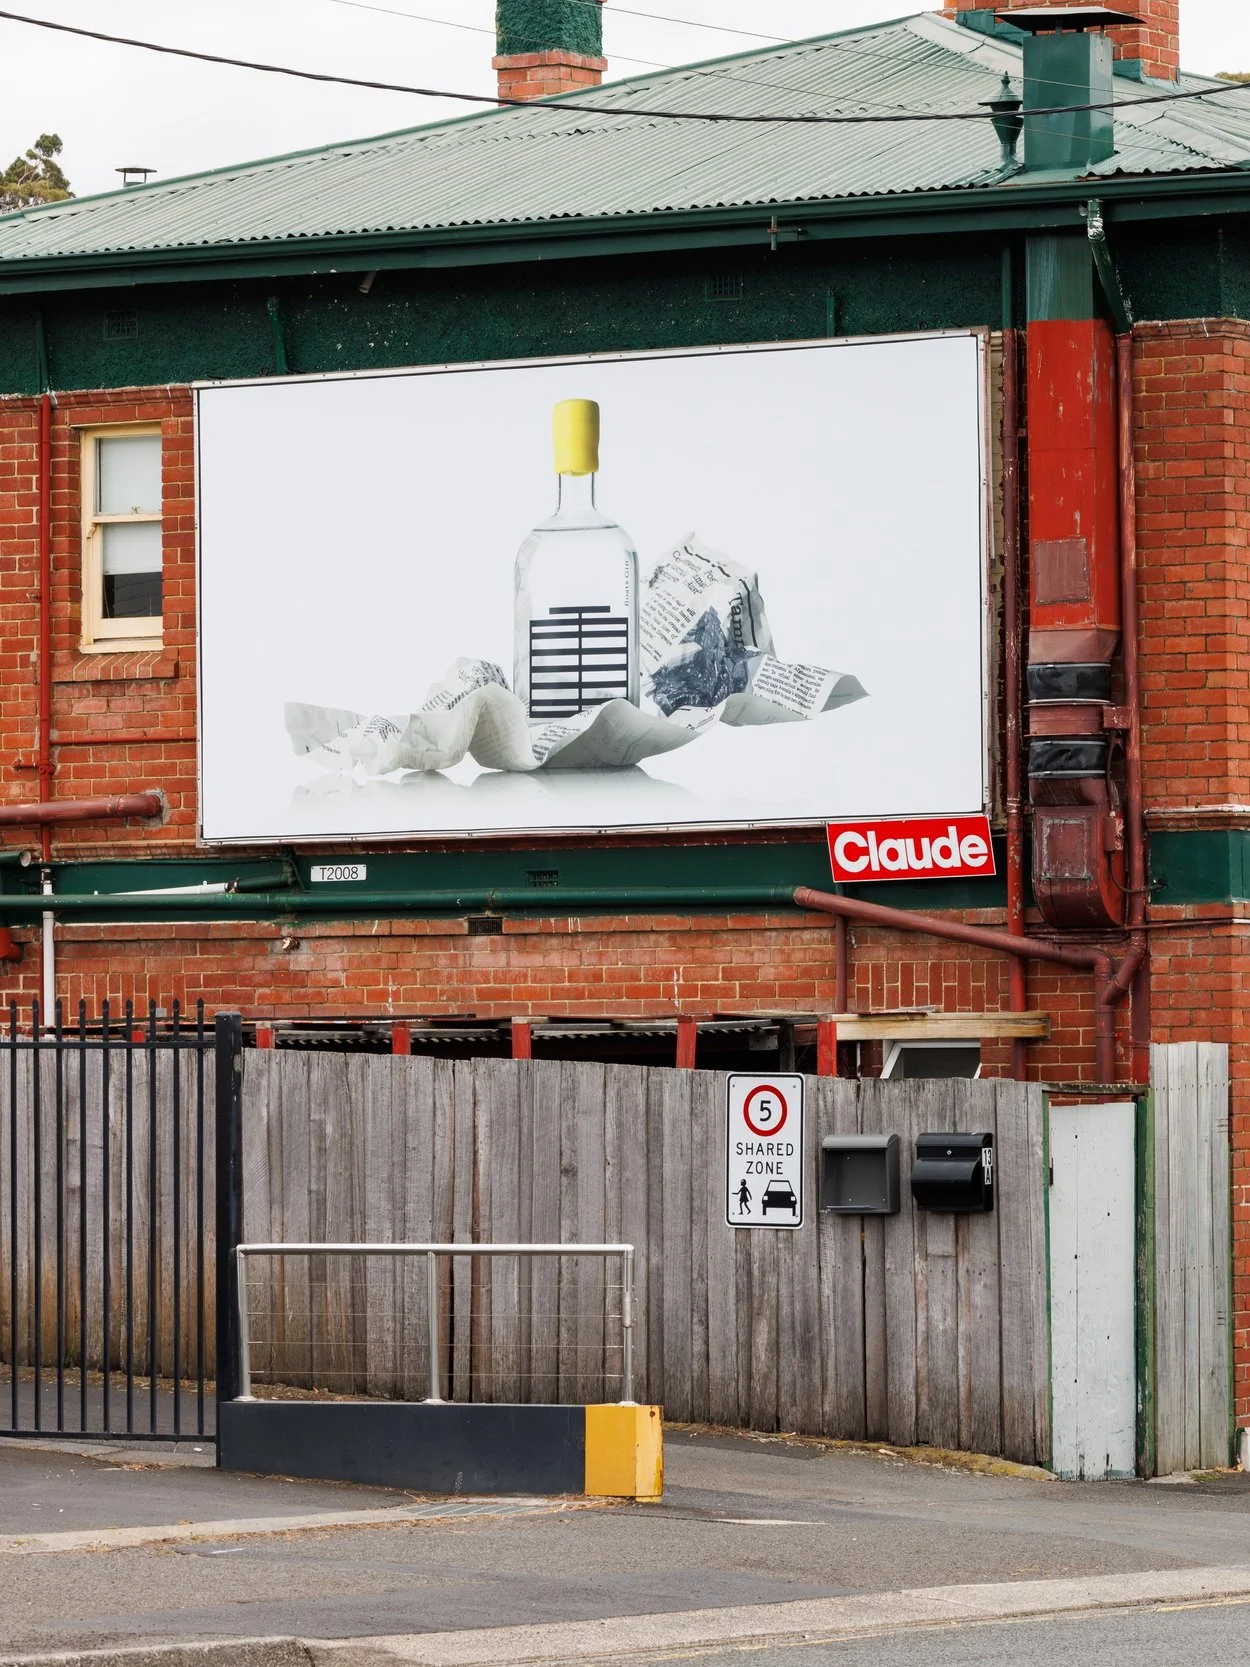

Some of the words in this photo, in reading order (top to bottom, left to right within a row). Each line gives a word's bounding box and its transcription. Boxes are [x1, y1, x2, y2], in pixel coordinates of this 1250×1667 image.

[833, 824, 990, 875] Claude
[317, 865, 361, 881] T2008
[759, 1099, 772, 1123] 5
[736, 1142, 794, 1157] SHARED
[983, 1149, 992, 1166] 13
[745, 1160, 784, 1175] ZONE
[985, 1167, 991, 1184] A
